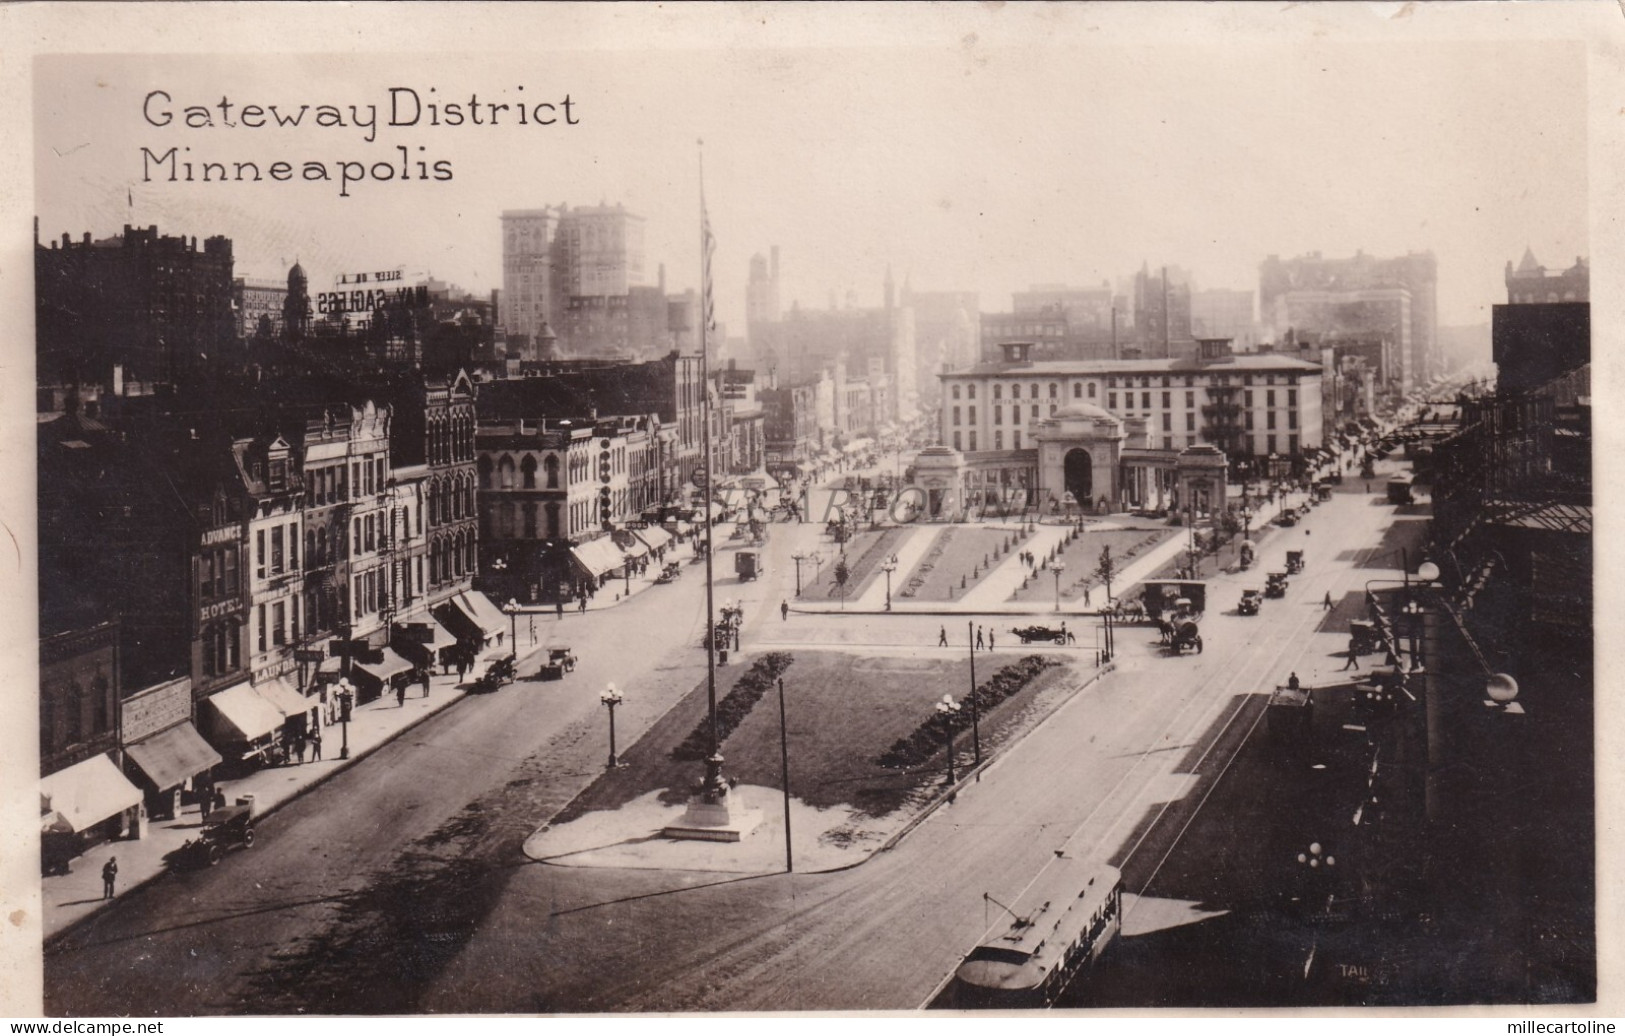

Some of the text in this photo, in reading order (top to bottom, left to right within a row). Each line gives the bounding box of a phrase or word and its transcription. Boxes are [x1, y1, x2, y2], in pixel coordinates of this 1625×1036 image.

[200, 524, 243, 547] ADVANCE
[200, 598, 243, 622] HOTEL
[255, 657, 300, 684] LAUNDR
